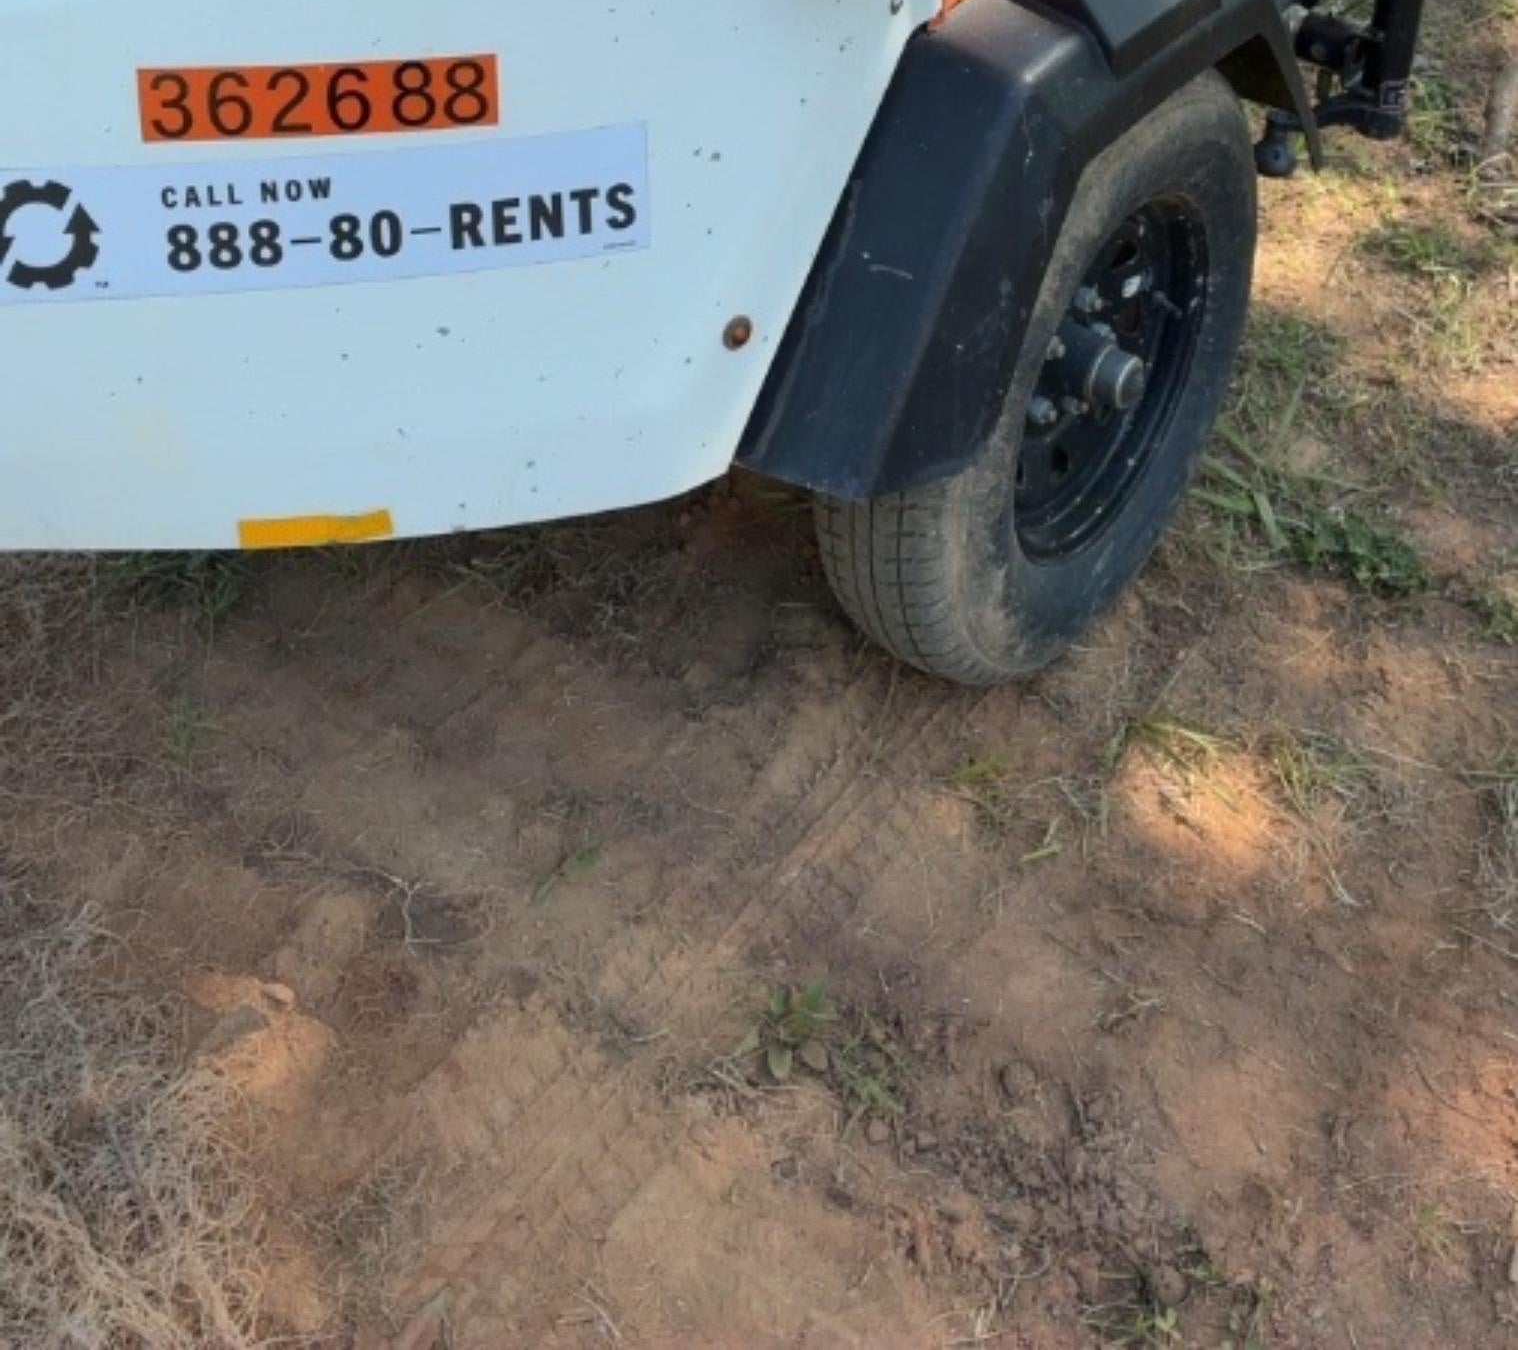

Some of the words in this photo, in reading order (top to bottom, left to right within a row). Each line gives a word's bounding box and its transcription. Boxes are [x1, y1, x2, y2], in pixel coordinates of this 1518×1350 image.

[149, 61, 490, 140] 362688
[160, 183, 243, 210] CALL
[259, 176, 332, 205] NOW
[166, 182, 638, 273] 888-80-RENTS
